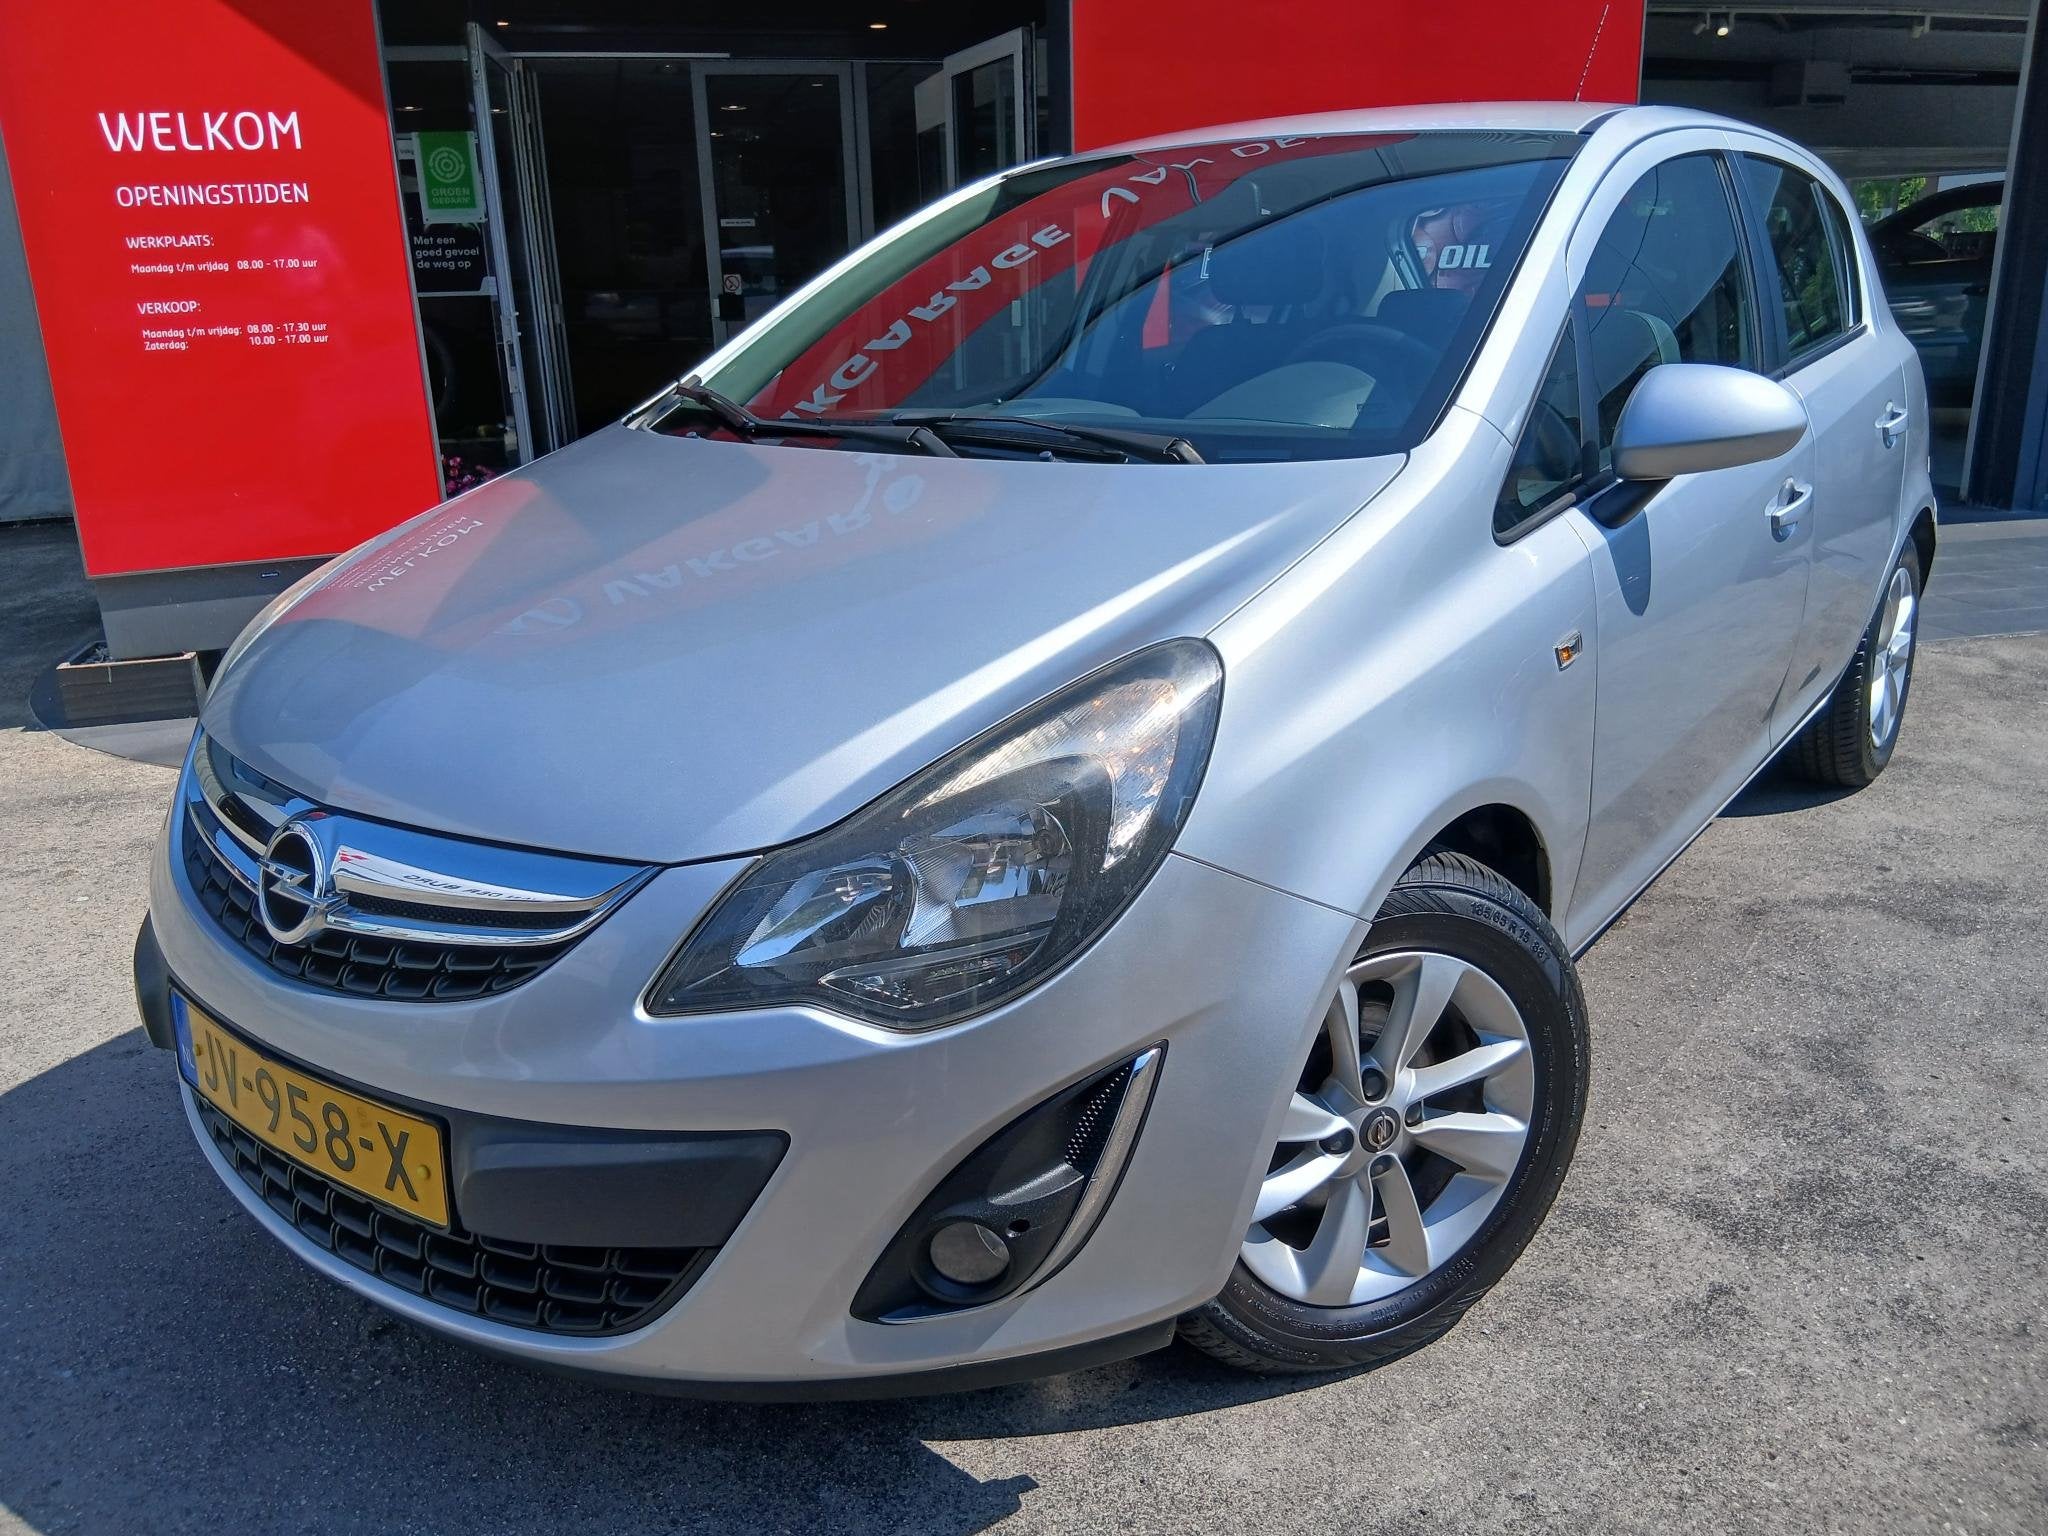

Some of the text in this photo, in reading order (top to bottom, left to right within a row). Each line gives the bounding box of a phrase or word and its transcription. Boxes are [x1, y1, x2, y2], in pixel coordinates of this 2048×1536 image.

[98, 110, 302, 152] WELKOM
[116, 183, 310, 207] OPENINGSTIJDEN
[126, 234, 215, 249] WERKPLAATS:
[413, 236, 456, 246] Met een
[415, 246, 480, 259] goed gevoel
[1438, 244, 1492, 269] OIL
[131, 262, 174, 274] Maandag
[176, 262, 195, 273] t/m
[197, 261, 230, 273] vrijdag
[236, 259, 264, 270] 08.00
[273, 258, 300, 269] 17.00
[302, 259, 318, 268] uur
[416, 260, 472, 270] de weg op
[136, 300, 202, 315] VERKOOP:
[142, 328, 185, 340] Maandag
[187, 327, 206, 338] t/m
[208, 325, 243, 337] vrijdag:
[247, 323, 274, 334] 08.00
[283, 322, 310, 333] 17.30
[311, 323, 327, 332] uur
[143, 340, 189, 352] Zaterdag:
[249, 335, 276, 346] 10.00
[285, 334, 311, 345] 17.00
[313, 335, 329, 343] uur
[204, 1029, 419, 1202] JV-958-X
